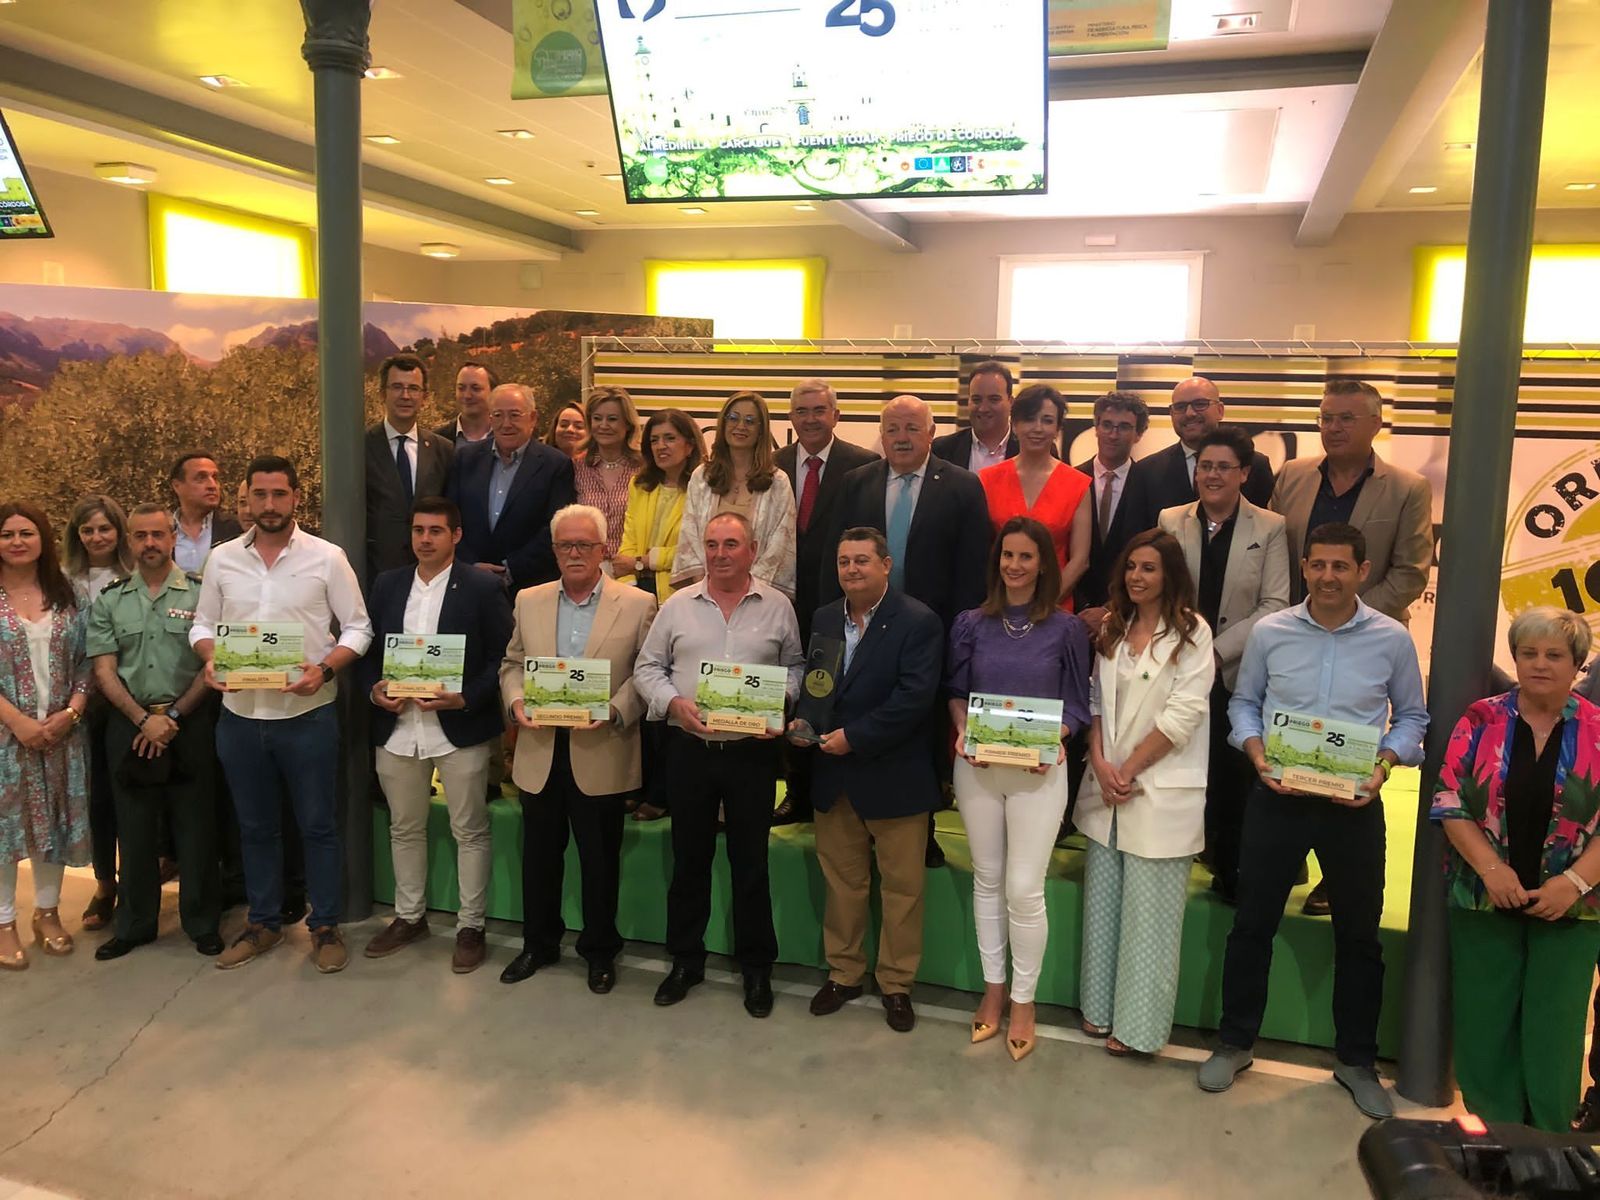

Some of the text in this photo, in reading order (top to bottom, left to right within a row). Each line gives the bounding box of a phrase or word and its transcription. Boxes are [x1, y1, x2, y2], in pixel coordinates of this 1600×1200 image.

[825, 0, 896, 37] 25
[1525, 457, 1600, 539] OR
[262, 633, 278, 645] 25
[427, 645, 441, 657] 25
[569, 669, 585, 682] 25
[744, 675, 760, 688] 25
[1326, 732, 1345, 747] 25
[1292, 773, 1345, 789] TERCER PREMIO
